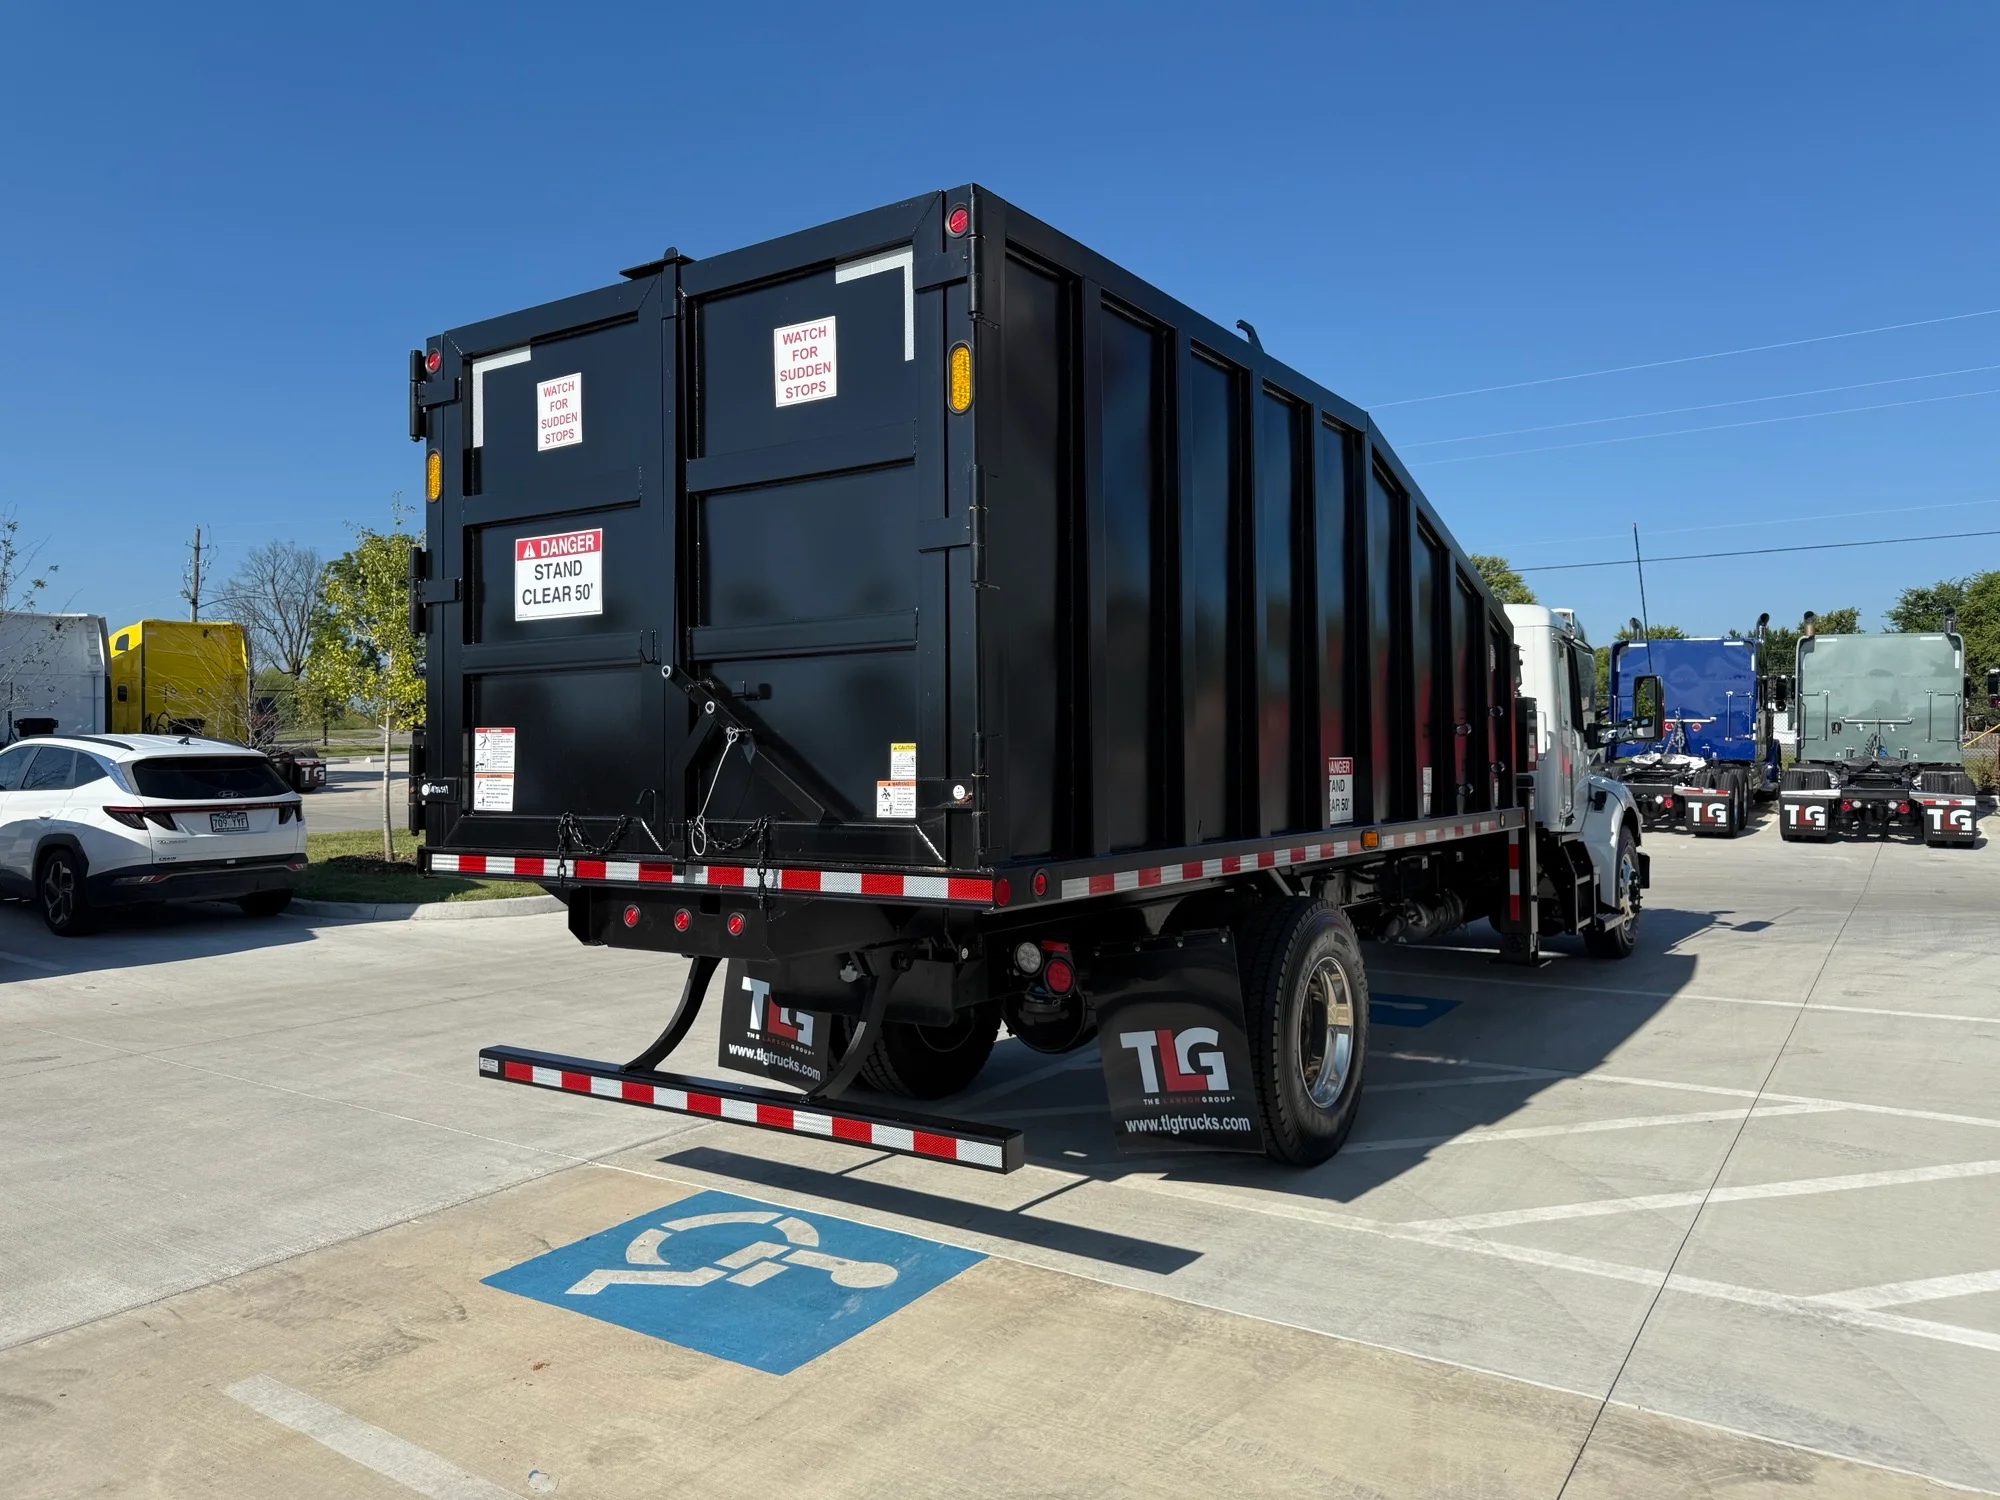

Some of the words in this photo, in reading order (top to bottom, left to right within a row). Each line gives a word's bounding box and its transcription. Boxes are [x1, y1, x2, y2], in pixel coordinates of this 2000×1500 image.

[783, 326, 826, 345] WATCH
[792, 346, 818, 362] FOR
[780, 361, 831, 382] SUDDEN
[543, 381, 575, 397] WATCH
[786, 381, 826, 399] STOPS
[550, 398, 568, 412] FOR
[541, 412, 578, 429] SUDDEN
[545, 428, 575, 444] STOPS
[540, 534, 595, 557] DANGER
[534, 560, 582, 580] STAND
[522, 585, 571, 605] CLEAR
[575, 583, 593, 601] 50'
[1688, 802, 1727, 823] TLG
[1784, 804, 1826, 827] TLG
[1927, 808, 1972, 831] TLG
[742, 976, 814, 1047] TLG
[746, 1031, 760, 1040] THE
[728, 1043, 821, 1081] www.tlgtrucks.com
[1119, 1027, 1230, 1094] TLG
[1125, 1113, 1251, 1135] www.tlgtrucks.com
